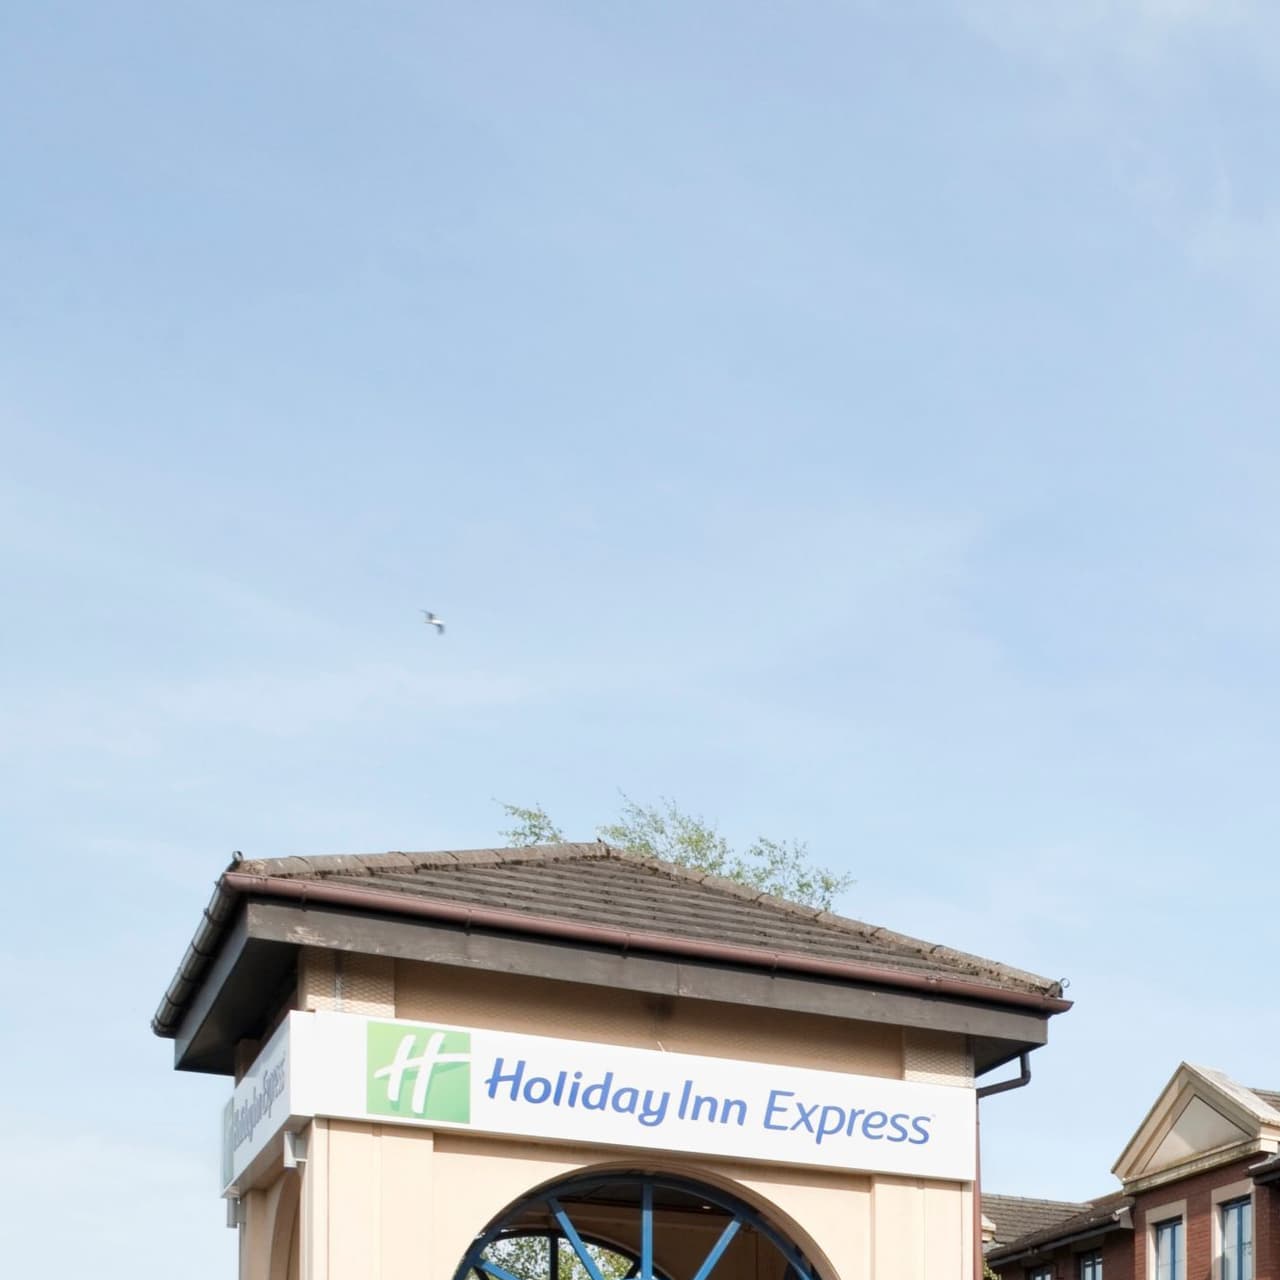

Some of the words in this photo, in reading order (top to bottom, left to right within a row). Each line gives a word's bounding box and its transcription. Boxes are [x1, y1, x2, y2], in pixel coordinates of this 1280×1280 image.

[484, 1057, 671, 1127] Holiday
[677, 1079, 748, 1126] Inn
[763, 1089, 932, 1145] Express
